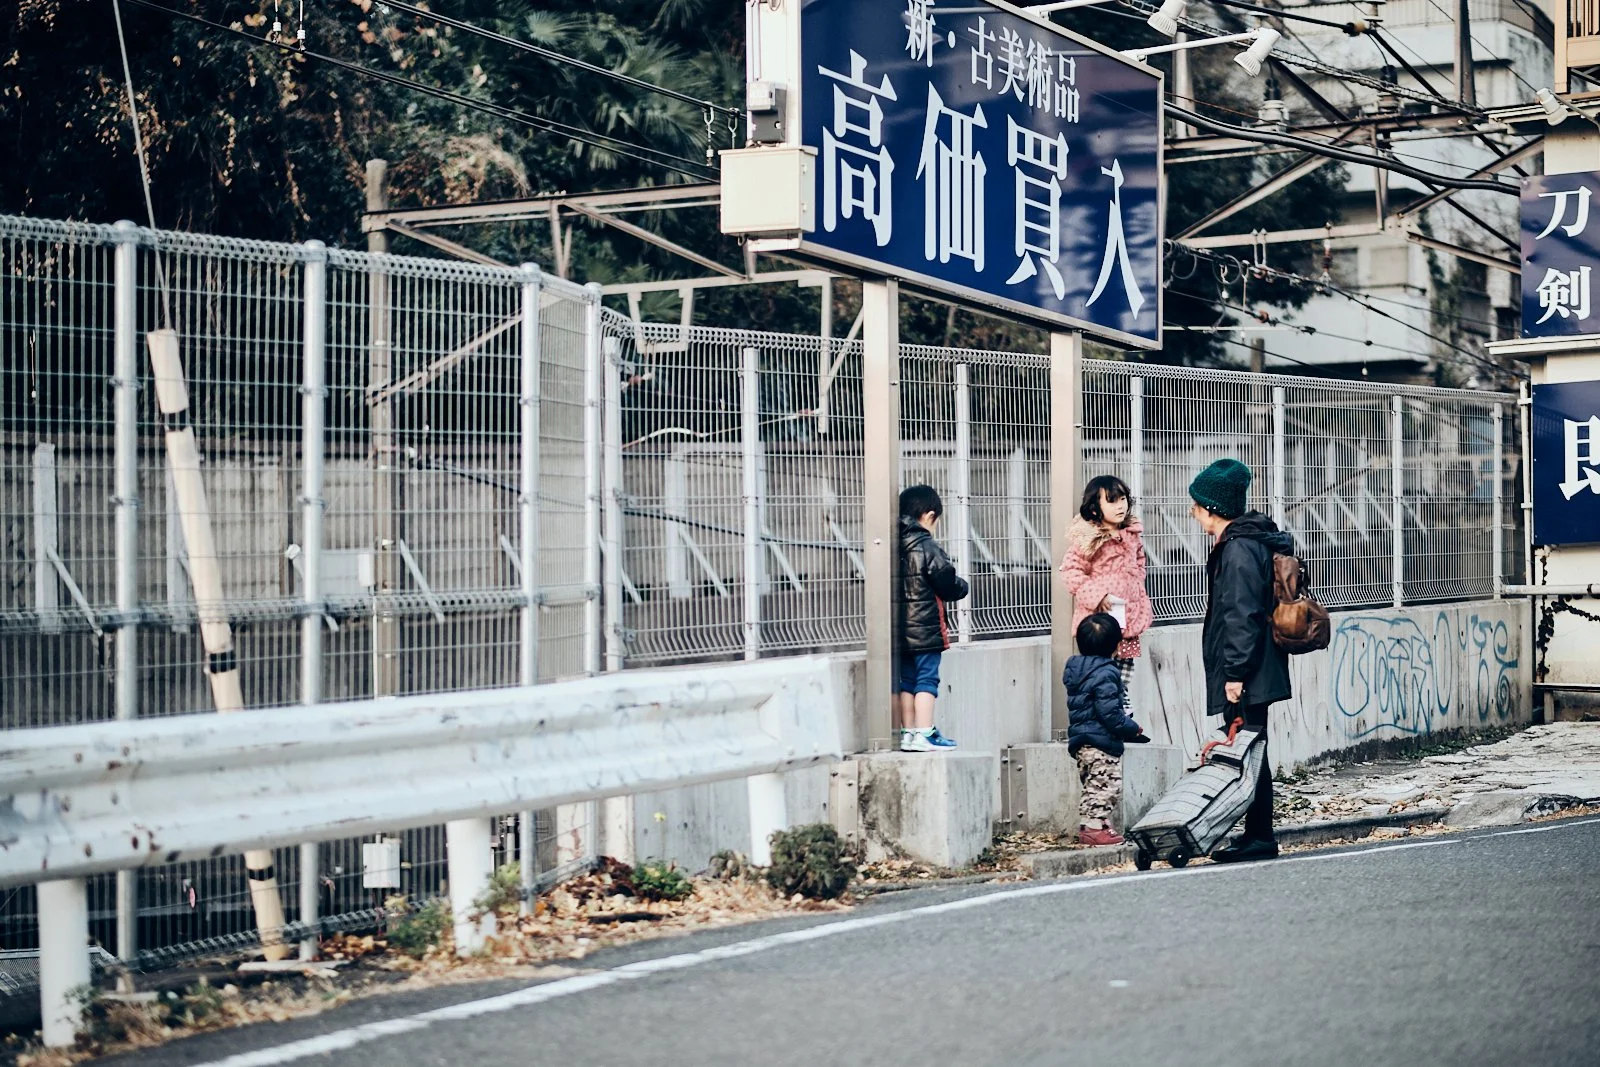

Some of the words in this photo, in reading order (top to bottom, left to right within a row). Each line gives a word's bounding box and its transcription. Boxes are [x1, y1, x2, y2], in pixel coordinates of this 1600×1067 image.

[818, 49, 1145, 320] 高価買入
[1535, 185, 1592, 325] 刀剣
